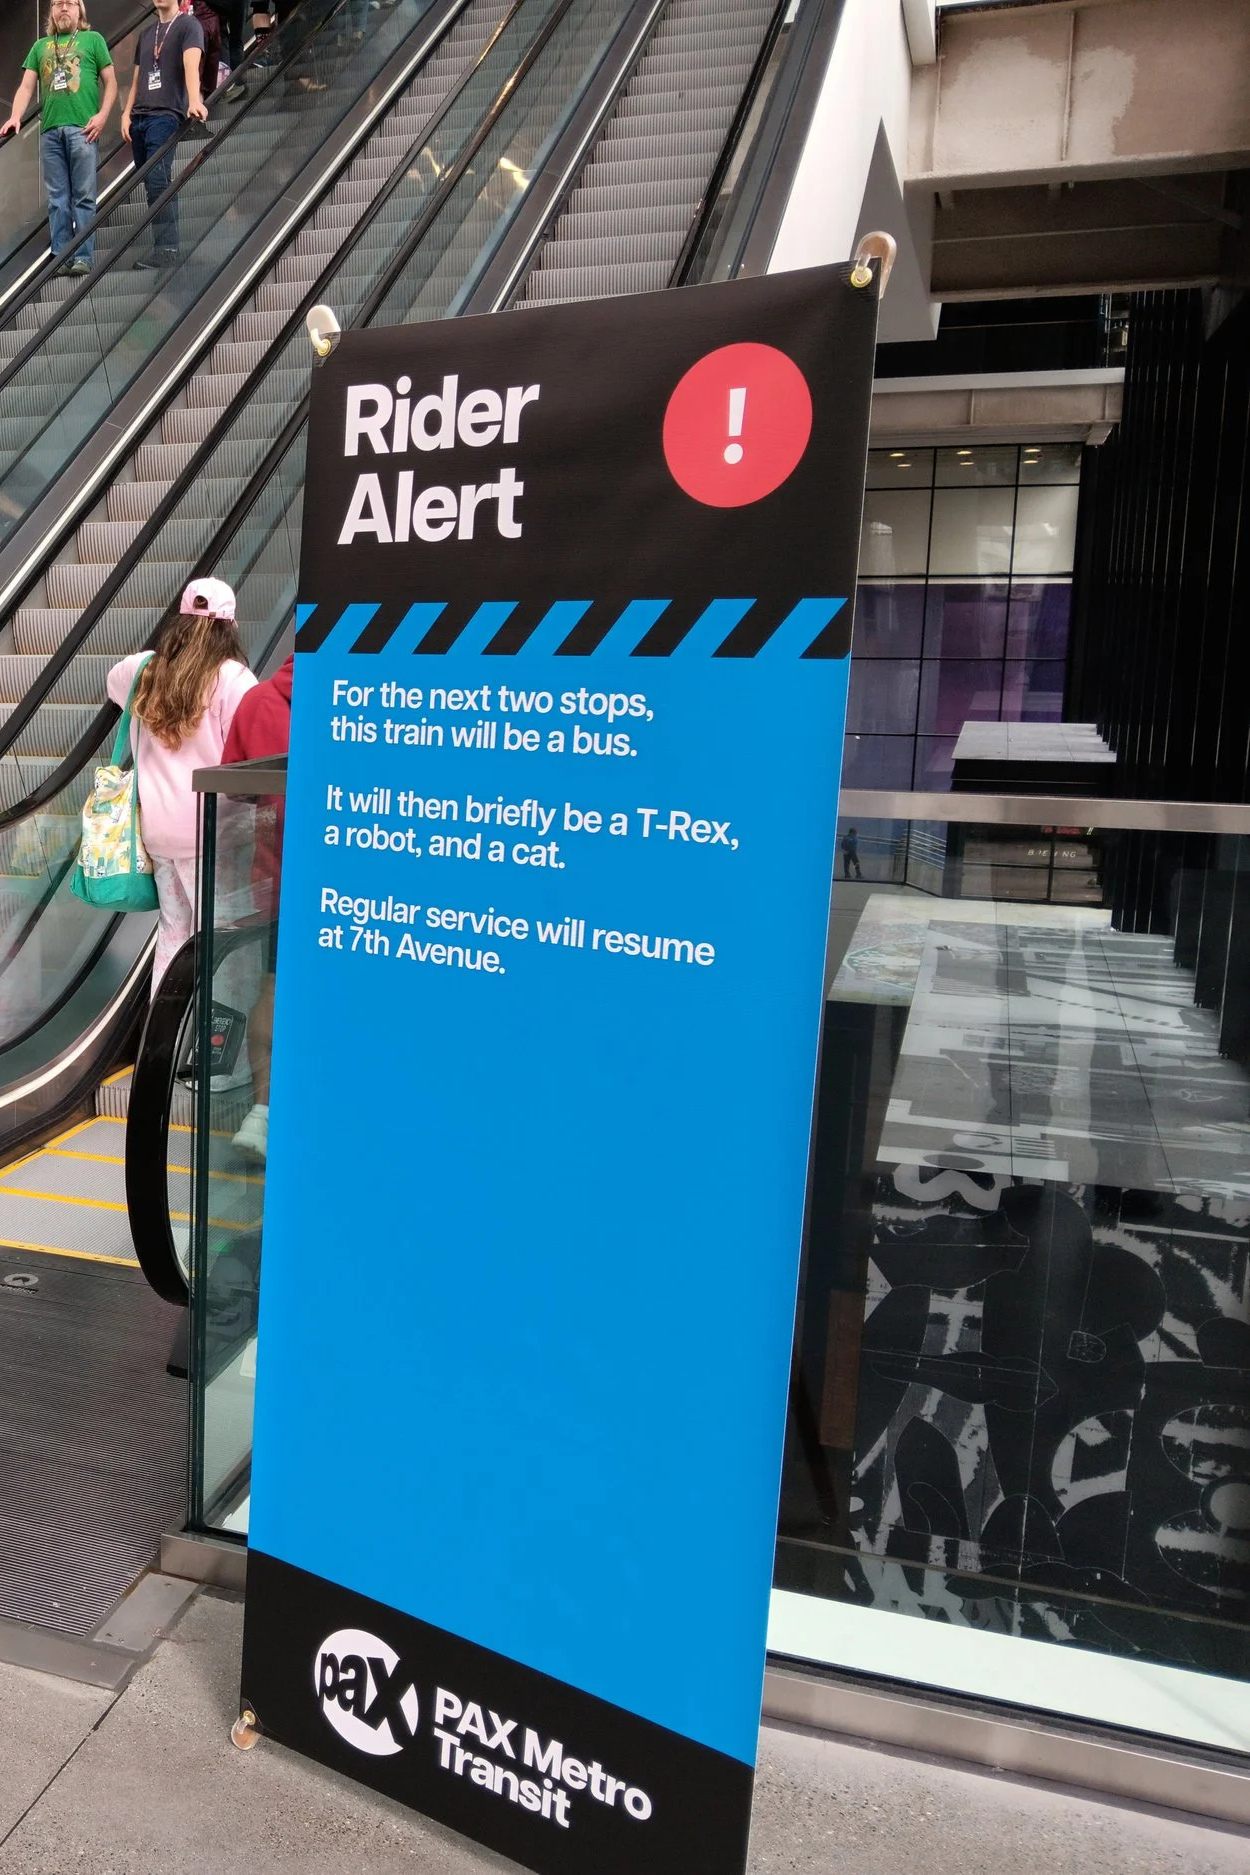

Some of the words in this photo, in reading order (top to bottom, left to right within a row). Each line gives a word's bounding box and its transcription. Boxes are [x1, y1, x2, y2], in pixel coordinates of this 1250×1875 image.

[344, 374, 541, 457] Rider
[723, 387, 747, 465] !
[336, 467, 525, 545] Alert
[330, 714, 378, 743] this
[383, 717, 444, 747] train
[450, 719, 497, 749] will
[503, 722, 541, 752] be
[546, 730, 565, 753] a
[572, 724, 638, 757] bus.
[332, 679, 375, 707] For
[379, 681, 423, 709] the
[429, 685, 492, 712] next
[497, 685, 554, 714] two
[559, 687, 654, 724] stops,
[324, 825, 340, 846] a
[345, 823, 422, 858] robot,
[428, 832, 482, 860] and
[487, 840, 505, 863] a
[511, 841, 566, 869] cat.
[326, 784, 344, 811] It
[349, 786, 391, 815] will
[397, 790, 459, 821] then
[465, 794, 557, 836] briefly
[563, 802, 603, 834] be
[609, 812, 628, 836] a
[636, 807, 739, 851] T-Rex,
[318, 925, 344, 950] at
[349, 925, 390, 957] 7th
[395, 932, 506, 975] Avenue.
[320, 887, 421, 925] Regular
[425, 906, 529, 940] service
[536, 916, 586, 948] will
[592, 928, 716, 966] resume
[433, 1726, 571, 1829] Transit
[434, 1686, 519, 1760] PAX
[523, 1727, 653, 1821] Metro
